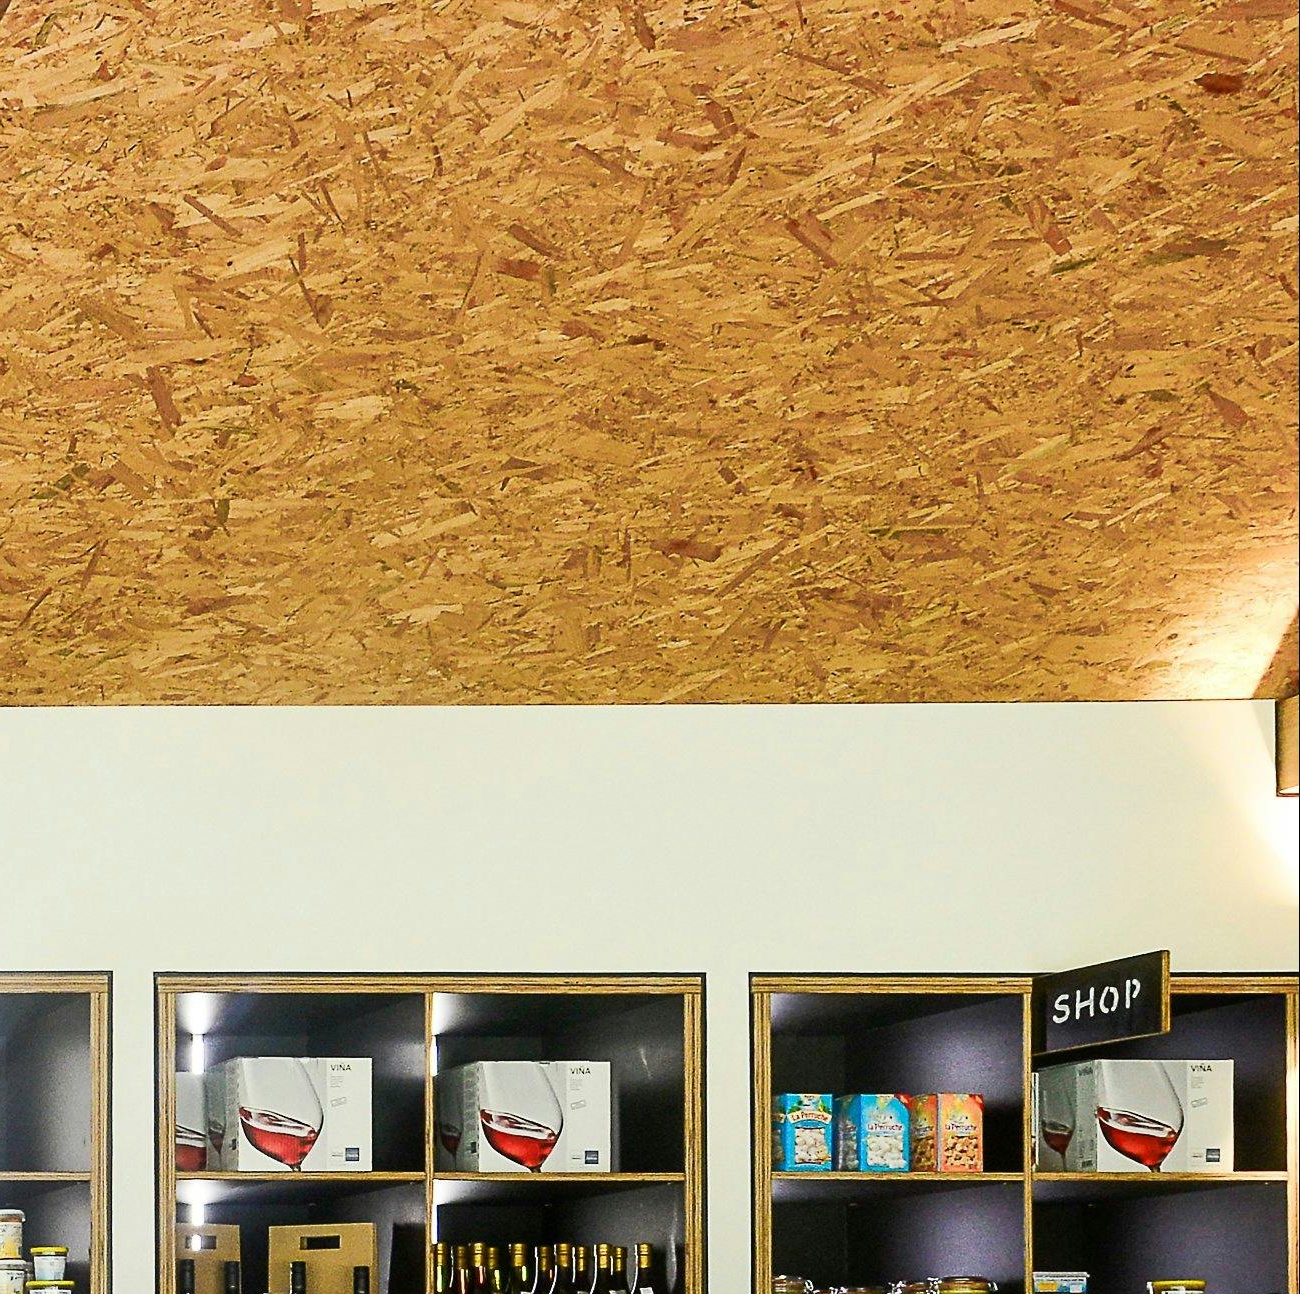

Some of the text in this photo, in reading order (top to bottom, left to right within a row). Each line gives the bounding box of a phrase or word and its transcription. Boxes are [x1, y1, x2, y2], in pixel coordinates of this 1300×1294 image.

[1052, 978, 1141, 1024] SHOP
[330, 1062, 352, 1071] VIÑA
[570, 1066, 591, 1075] VIÑA
[1190, 1063, 1213, 1072] VIÑA
[801, 1111, 829, 1122] Perruche
[874, 1122, 903, 1131] Perruche
